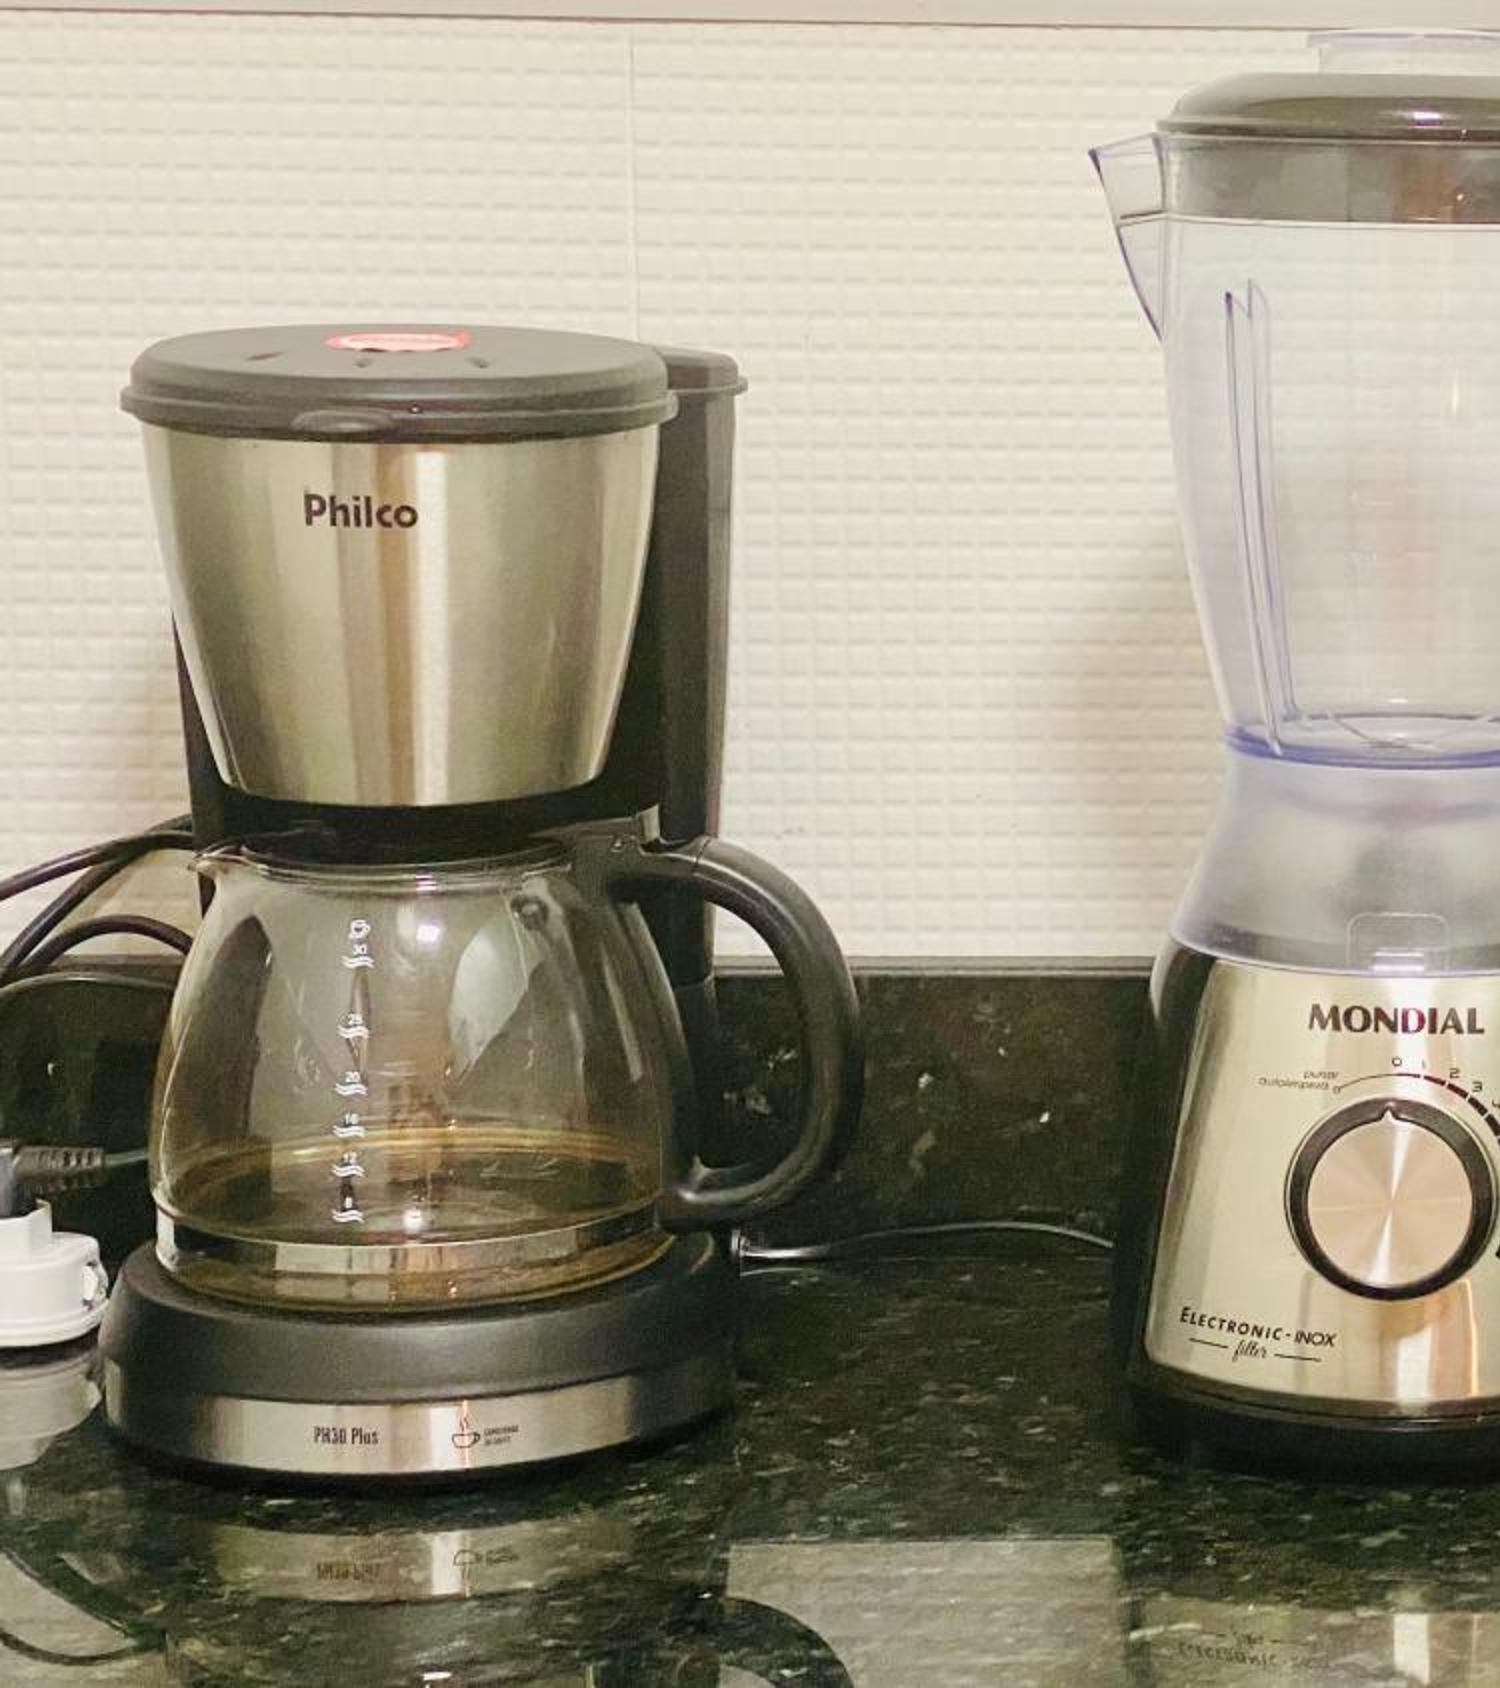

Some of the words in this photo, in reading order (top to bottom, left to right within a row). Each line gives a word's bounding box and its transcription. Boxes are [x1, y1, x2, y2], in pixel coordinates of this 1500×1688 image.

[304, 493, 418, 528] Philco
[1309, 1003, 1485, 1035] MONDIAL
[344, 1071, 361, 1082] 20
[1449, 1068, 1460, 1078] 2
[1471, 1081, 1483, 1092] 3
[1232, 1338, 1268, 1362] filter
[314, 1426, 347, 1444] PH30
[350, 1426, 379, 1444] Plus
